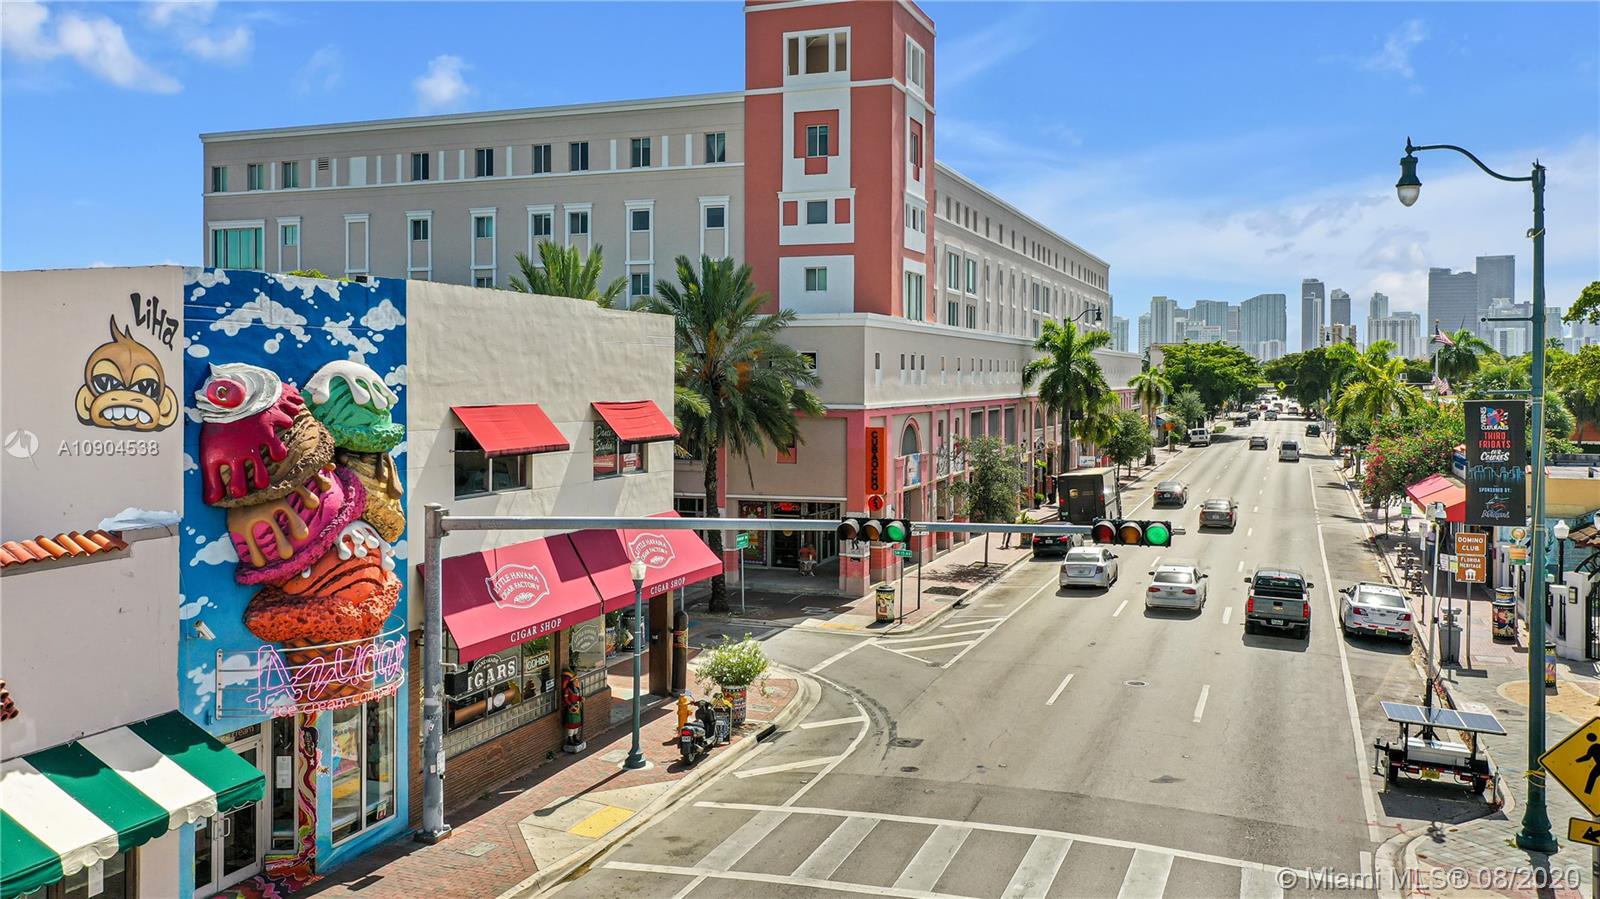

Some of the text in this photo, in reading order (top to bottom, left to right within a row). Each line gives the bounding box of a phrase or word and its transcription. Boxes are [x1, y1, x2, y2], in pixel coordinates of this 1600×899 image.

[1478, 440, 1511, 449] FRIDAYS
[1484, 432, 1506, 440] THIRD
[871, 430, 879, 491] CUBAOCHO
[1457, 536, 1484, 544] DOMINO
[493, 571, 540, 595] LITTLE HAVANA
[501, 581, 540, 601] CIGAR FACTORY
[650, 576, 686, 595] CIGAR SHOP
[510, 617, 562, 643] CIGAR SHOP
[467, 660, 516, 692] IGARS
[302, 695, 350, 715] cream
